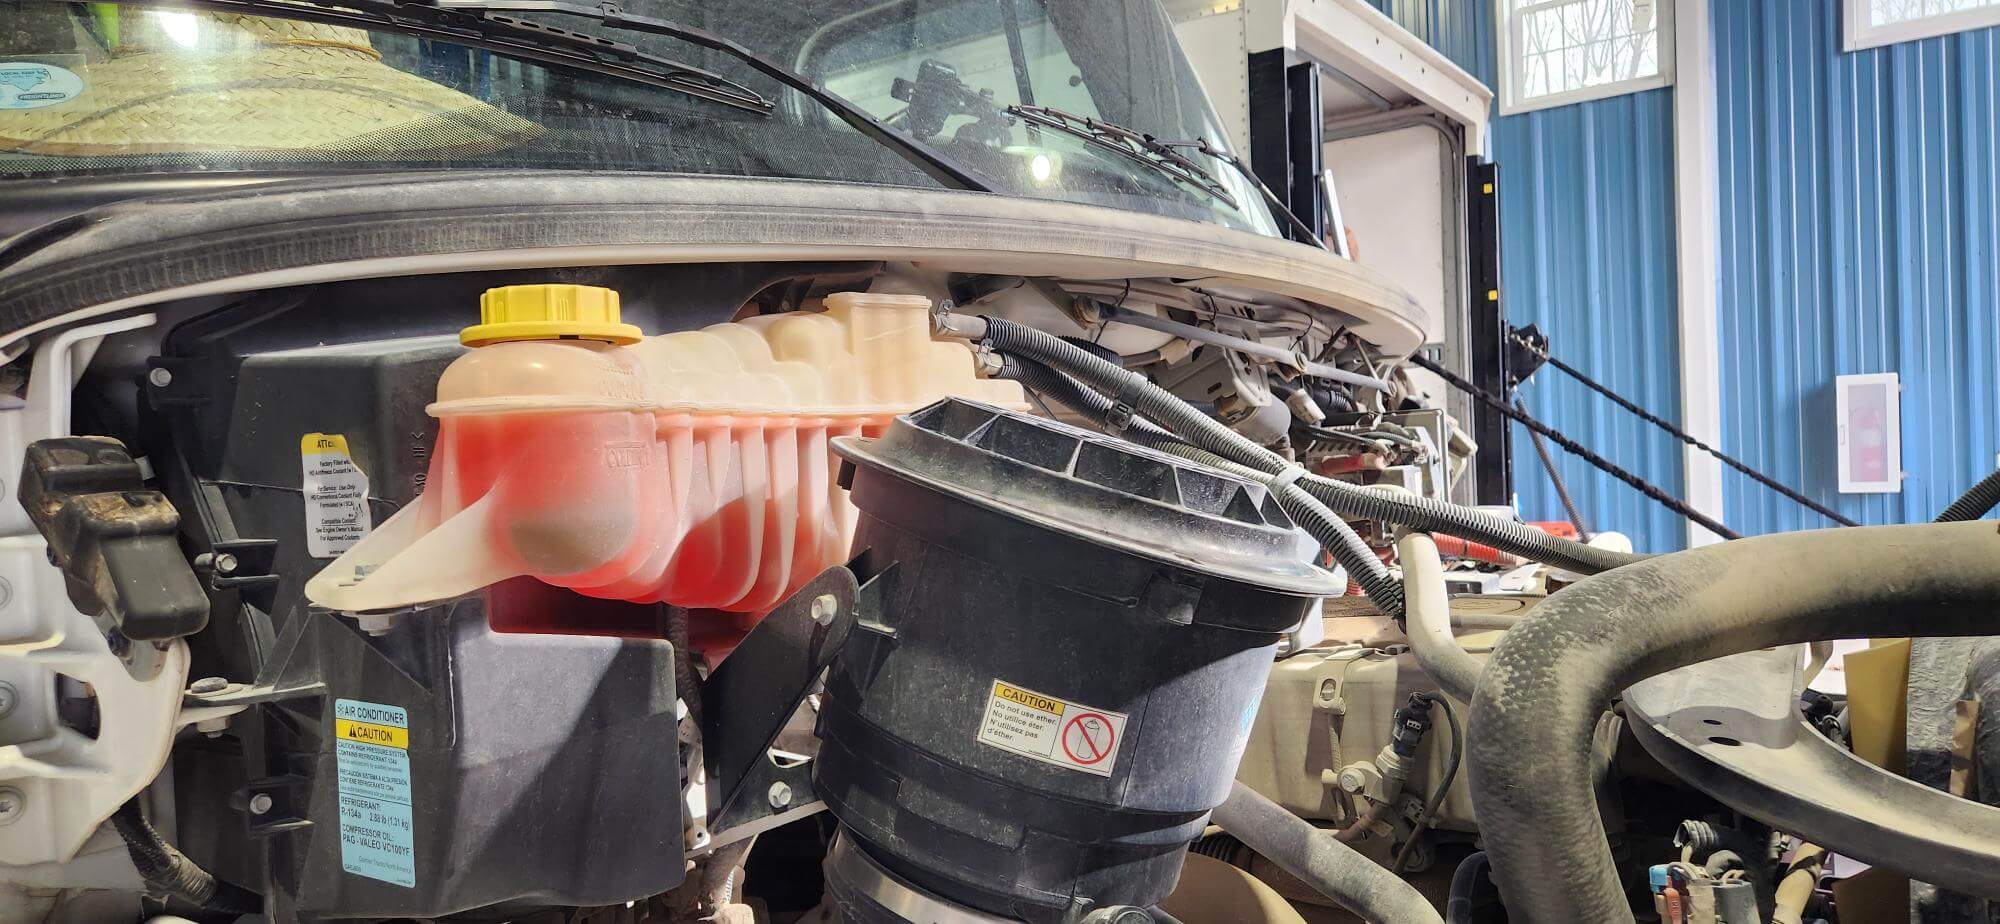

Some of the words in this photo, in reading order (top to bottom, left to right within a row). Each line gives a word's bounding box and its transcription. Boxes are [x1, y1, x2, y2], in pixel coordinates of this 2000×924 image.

[1002, 688, 1056, 712] CAUTION
[345, 705, 356, 717] AIR
[357, 708, 405, 724] CONDITIONER
[992, 710, 1003, 719] No
[1004, 713, 1027, 726] utilice
[994, 701, 1005, 710] Do
[1007, 704, 1020, 714] not
[1021, 710, 1035, 719] use
[1036, 714, 1057, 725] ether.
[358, 727, 393, 742] CAUTION
[990, 719, 1023, 735] N'utilisez
[1024, 730, 1038, 740] pas
[342, 806, 361, 819] R-134a
[382, 815, 387, 824] lb
[342, 824, 381, 839] COMPRESSOR
[343, 834, 356, 844] PAG
[360, 838, 381, 850] VALEO
[382, 842, 410, 856] VC100YF
